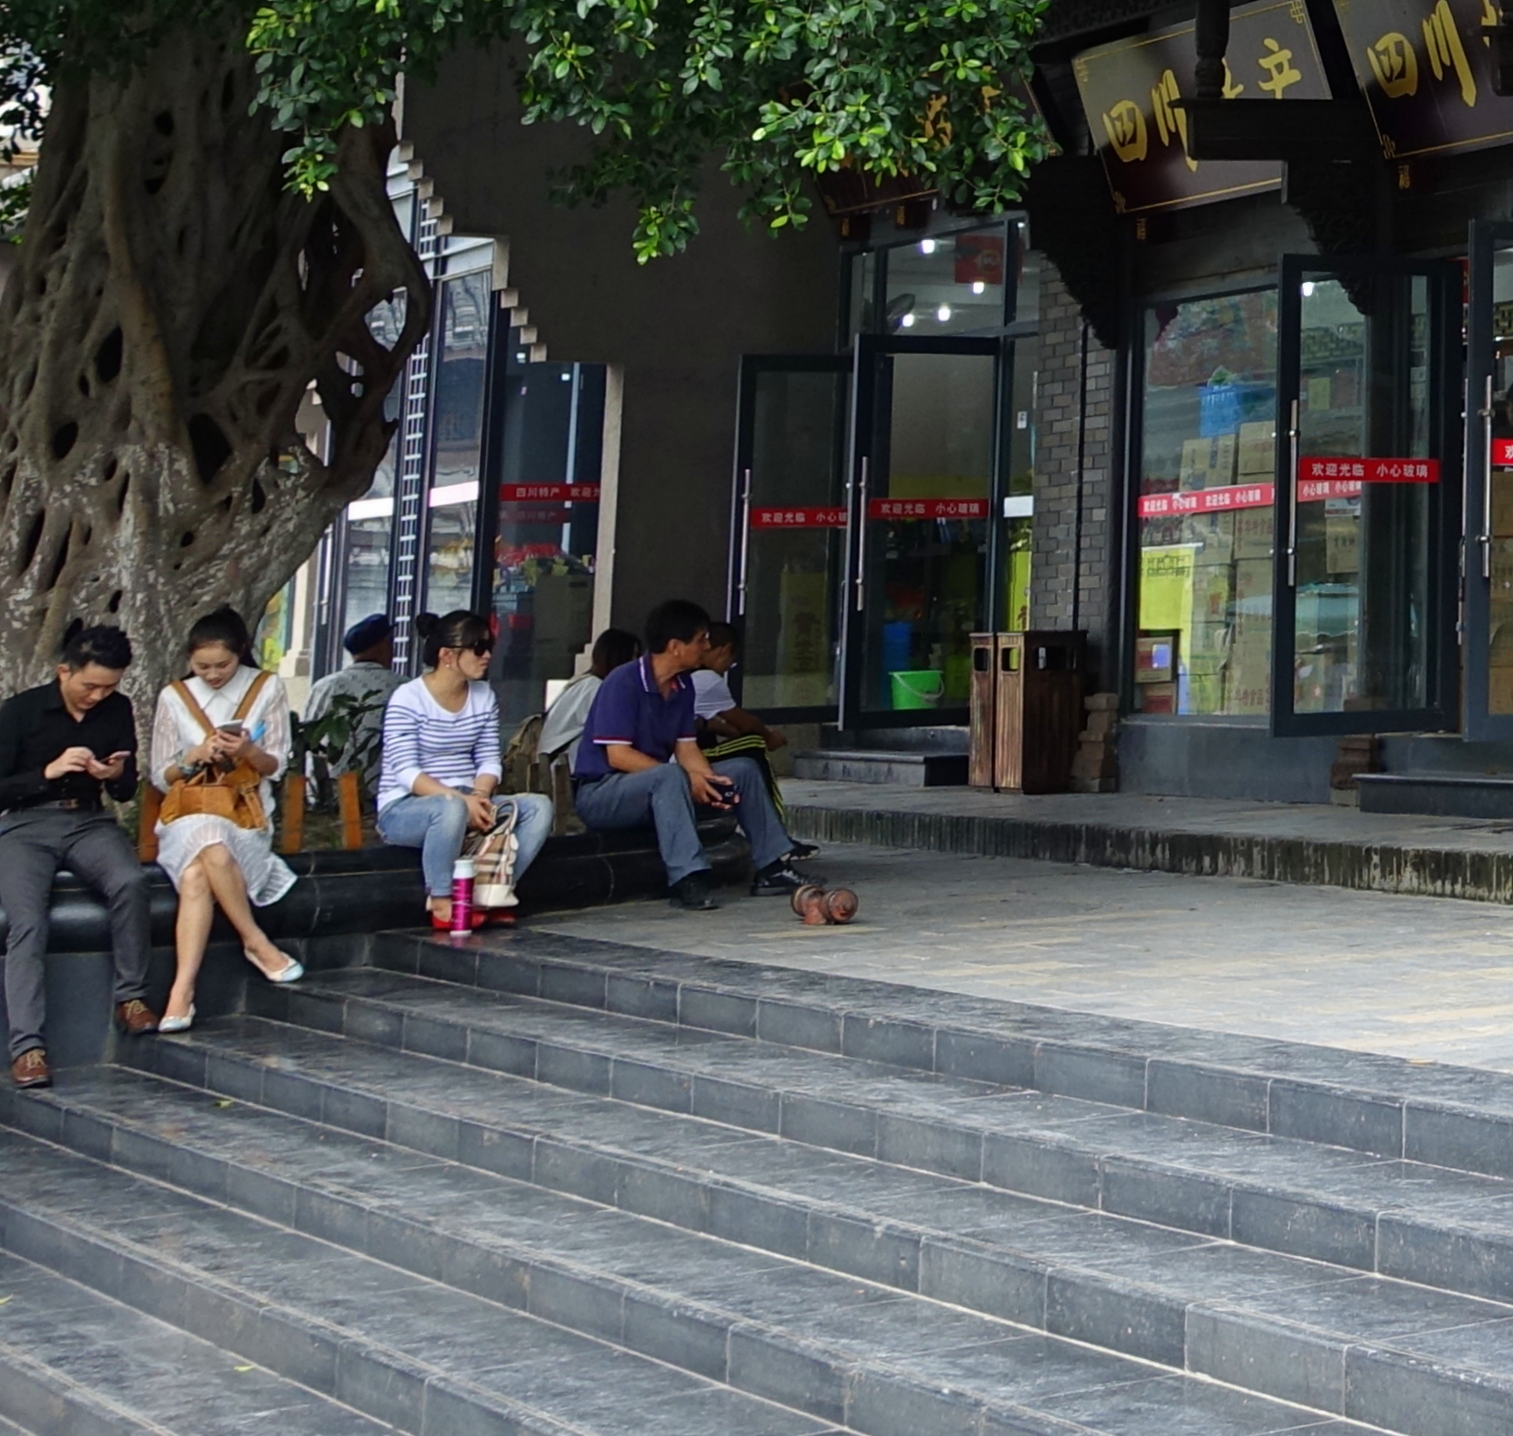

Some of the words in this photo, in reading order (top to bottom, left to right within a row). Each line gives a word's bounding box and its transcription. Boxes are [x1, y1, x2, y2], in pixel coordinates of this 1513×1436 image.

[1311, 462, 1365, 477] 欢迎光临
[1376, 463, 1429, 479] 小心玻璃
[516, 487, 560, 498] 四川特产
[880, 503, 926, 514] 欢迎光临
[935, 502, 980, 514] 小心玻璃
[761, 512, 806, 523] 欢迎光临
